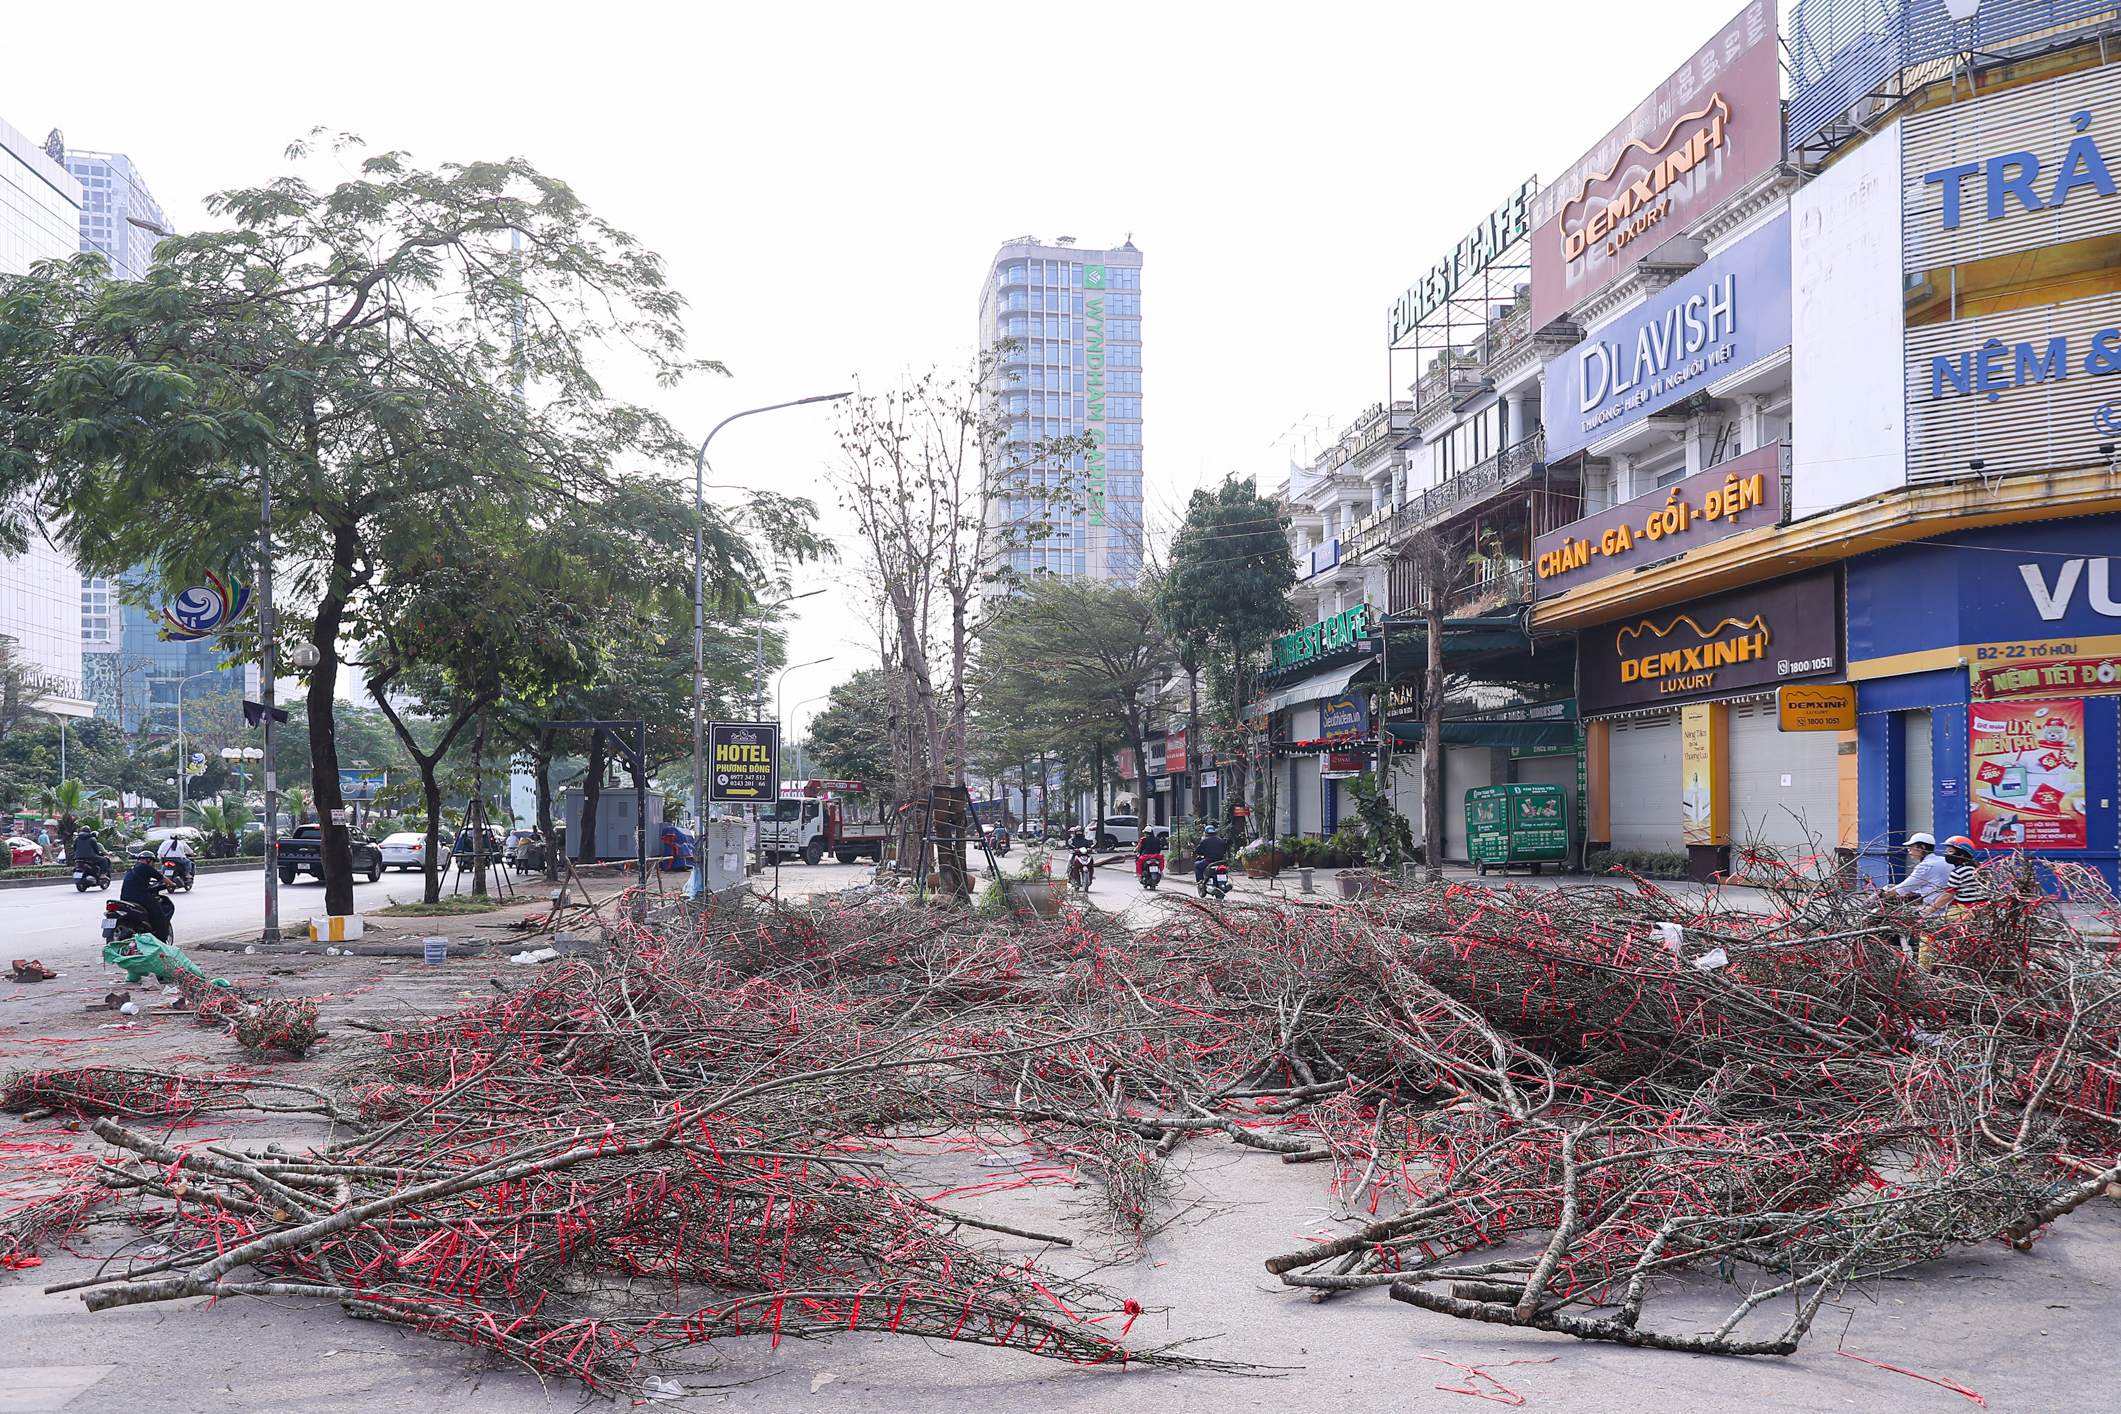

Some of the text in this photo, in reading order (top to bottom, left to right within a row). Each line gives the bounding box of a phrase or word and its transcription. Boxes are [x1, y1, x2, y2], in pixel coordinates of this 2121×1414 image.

[1566, 115, 1725, 263] DEMXINH
[1924, 110, 2119, 231] TRẢ
[1606, 198, 1672, 257] LUXURY
[1388, 184, 1526, 346] FOREST CAFE
[1931, 328, 2121, 402] NỆM &
[1580, 403, 1623, 433] THƯƠNG
[1624, 387, 1649, 411] HIỆU
[1665, 358, 1706, 390] NGƯỜI
[1707, 343, 1736, 366] VIỆT
[1086, 298, 1106, 526] WYNDHAM GARDEN
[1537, 534, 1592, 579] CHĂN
[1600, 523, 1634, 557] GA
[1646, 487, 1689, 541] GỐI
[1703, 473, 1764, 524] ĐỆM
[1325, 604, 1368, 651] CAFE
[1620, 632, 1764, 683] DEMXINH
[1789, 657, 1833, 674] 1800 1051
[1976, 645, 2027, 660] B2-22
[2030, 644, 2048, 657] TỐ
[19, 671, 83, 696] UNIVERSITY
[1660, 673, 1715, 694] LUXURY
[1991, 667, 2041, 692] NỆM
[2041, 660, 2077, 685] TẾT
[1788, 700, 1848, 710] DEMXINH
[1807, 717, 1840, 725] 1800 1051
[716, 744, 770, 762] HOTEL
[1974, 733, 2010, 756] MIỄN
[716, 763, 771, 773] PHƯƠNG ĐÔNG
